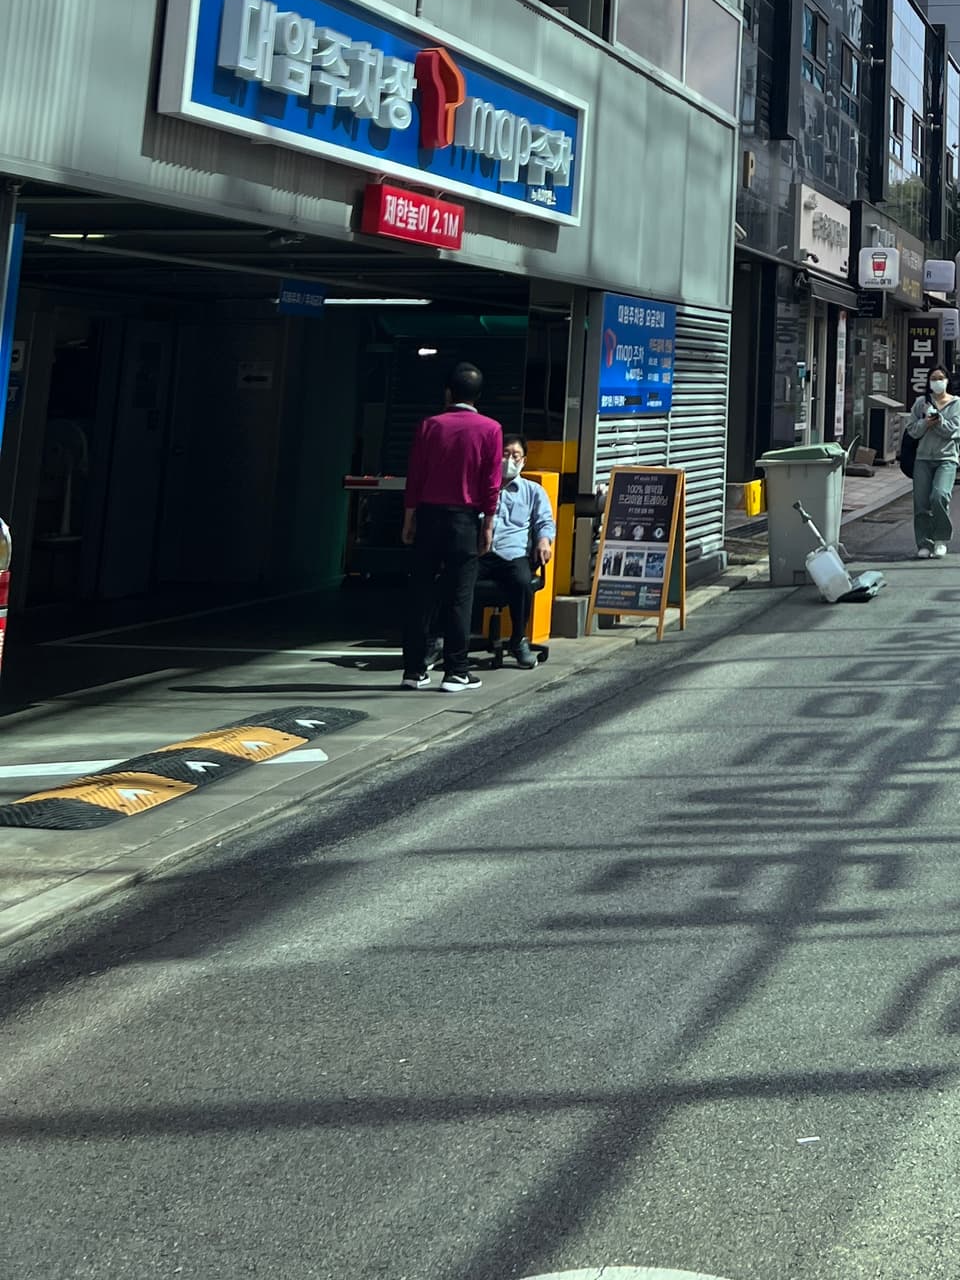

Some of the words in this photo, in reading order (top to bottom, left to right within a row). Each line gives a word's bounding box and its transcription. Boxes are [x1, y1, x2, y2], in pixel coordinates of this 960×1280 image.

[383, 194, 430, 233] 제한높이
[431, 208, 460, 238] 2.1M
[910, 338, 935, 393] 부동
